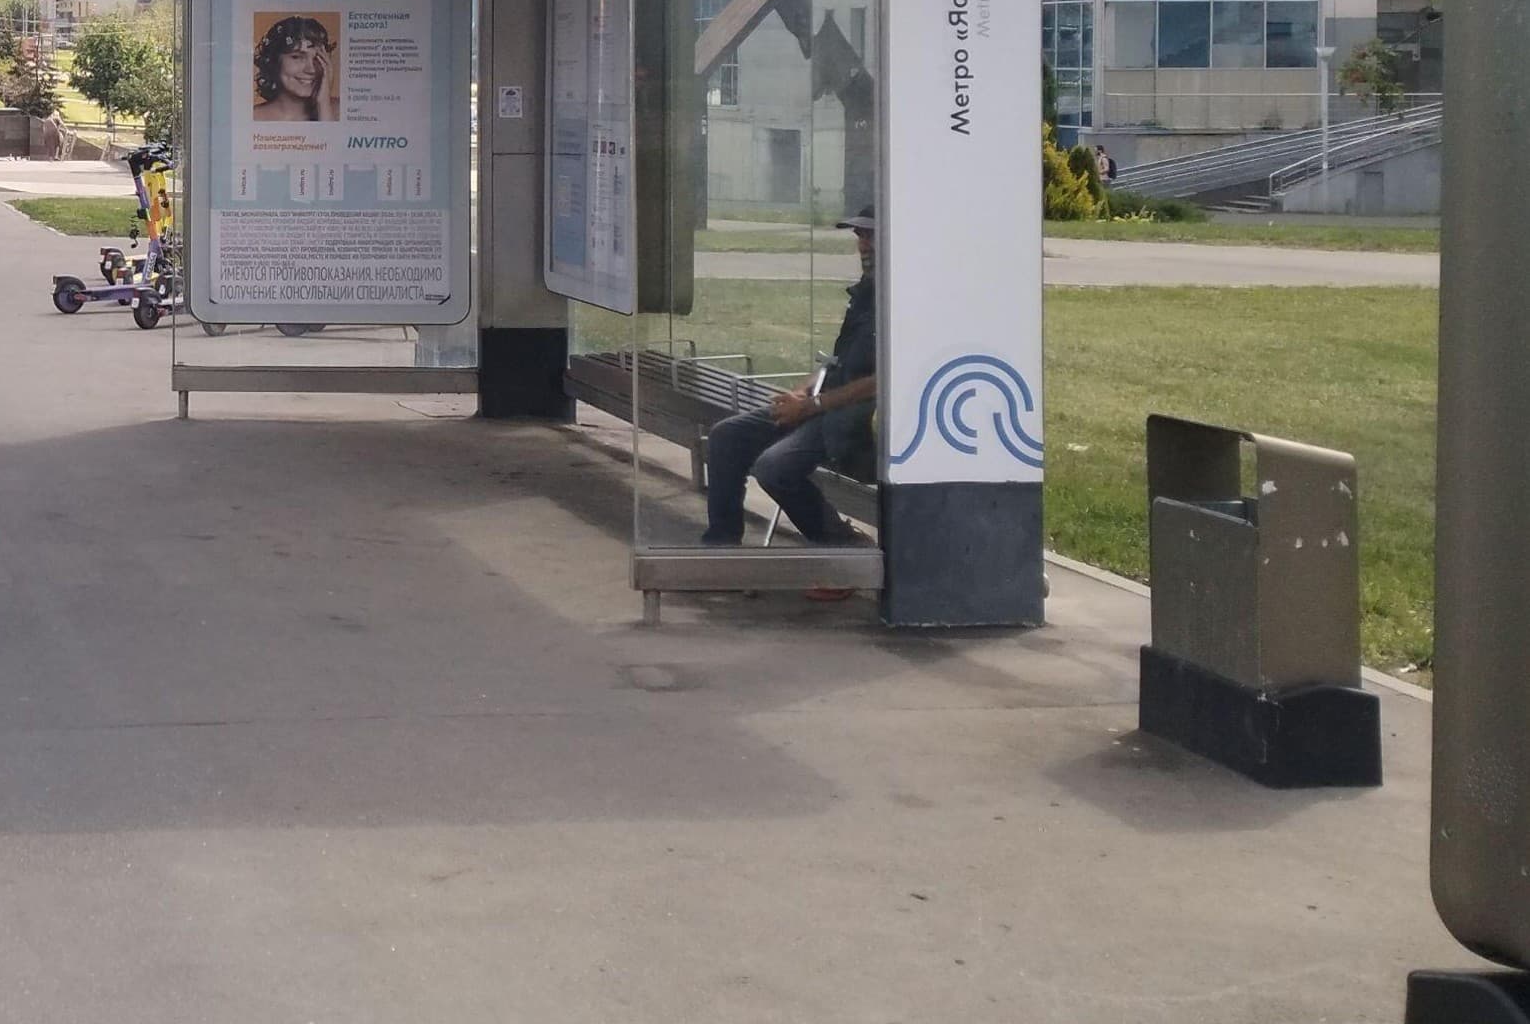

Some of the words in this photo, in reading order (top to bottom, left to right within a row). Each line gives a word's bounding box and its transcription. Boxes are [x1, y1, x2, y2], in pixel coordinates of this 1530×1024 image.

[950, 48, 974, 135] Метро
[347, 136, 408, 149] INVITRO
[220, 266, 266, 281] ИМЕЮТСЯ
[375, 266, 442, 283] НЕОБХОДИМО
[220, 285, 277, 300] ПОЛУЧЕНИЕ
[280, 285, 354, 301] КОНСУЛЬТАЦИИ
[356, 285, 425, 301] СПЕЦИАЛИСТА
